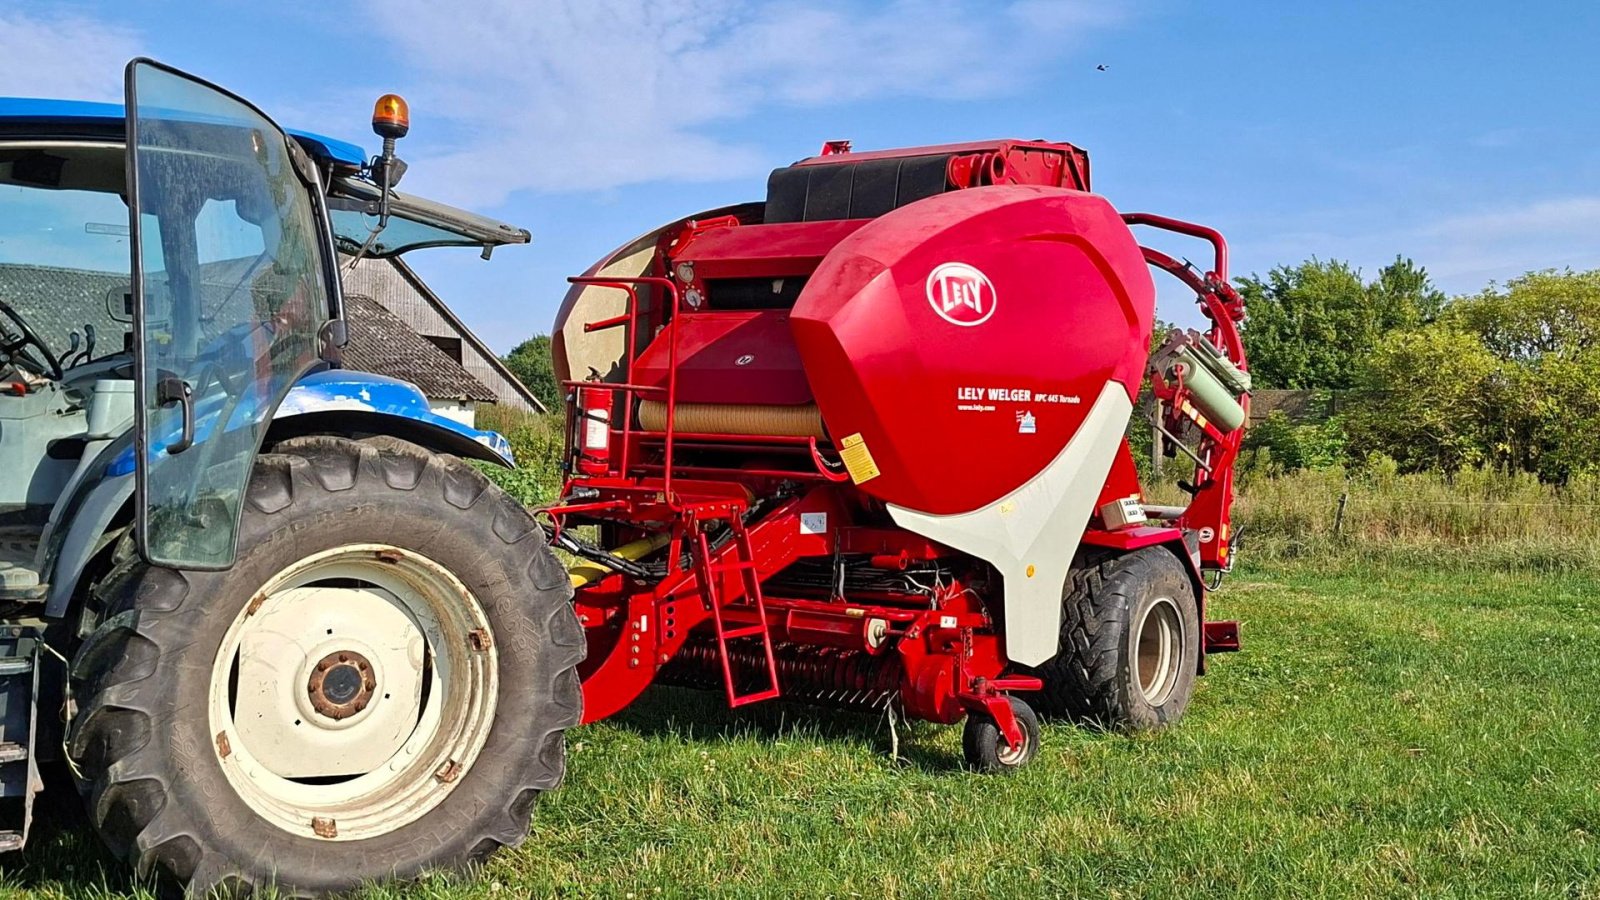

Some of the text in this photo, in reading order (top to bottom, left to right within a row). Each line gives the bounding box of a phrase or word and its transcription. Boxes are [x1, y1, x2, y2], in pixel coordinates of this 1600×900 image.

[938, 275, 984, 314] LELY
[957, 387, 985, 400] LELY
[988, 388, 1031, 402] WELGER
